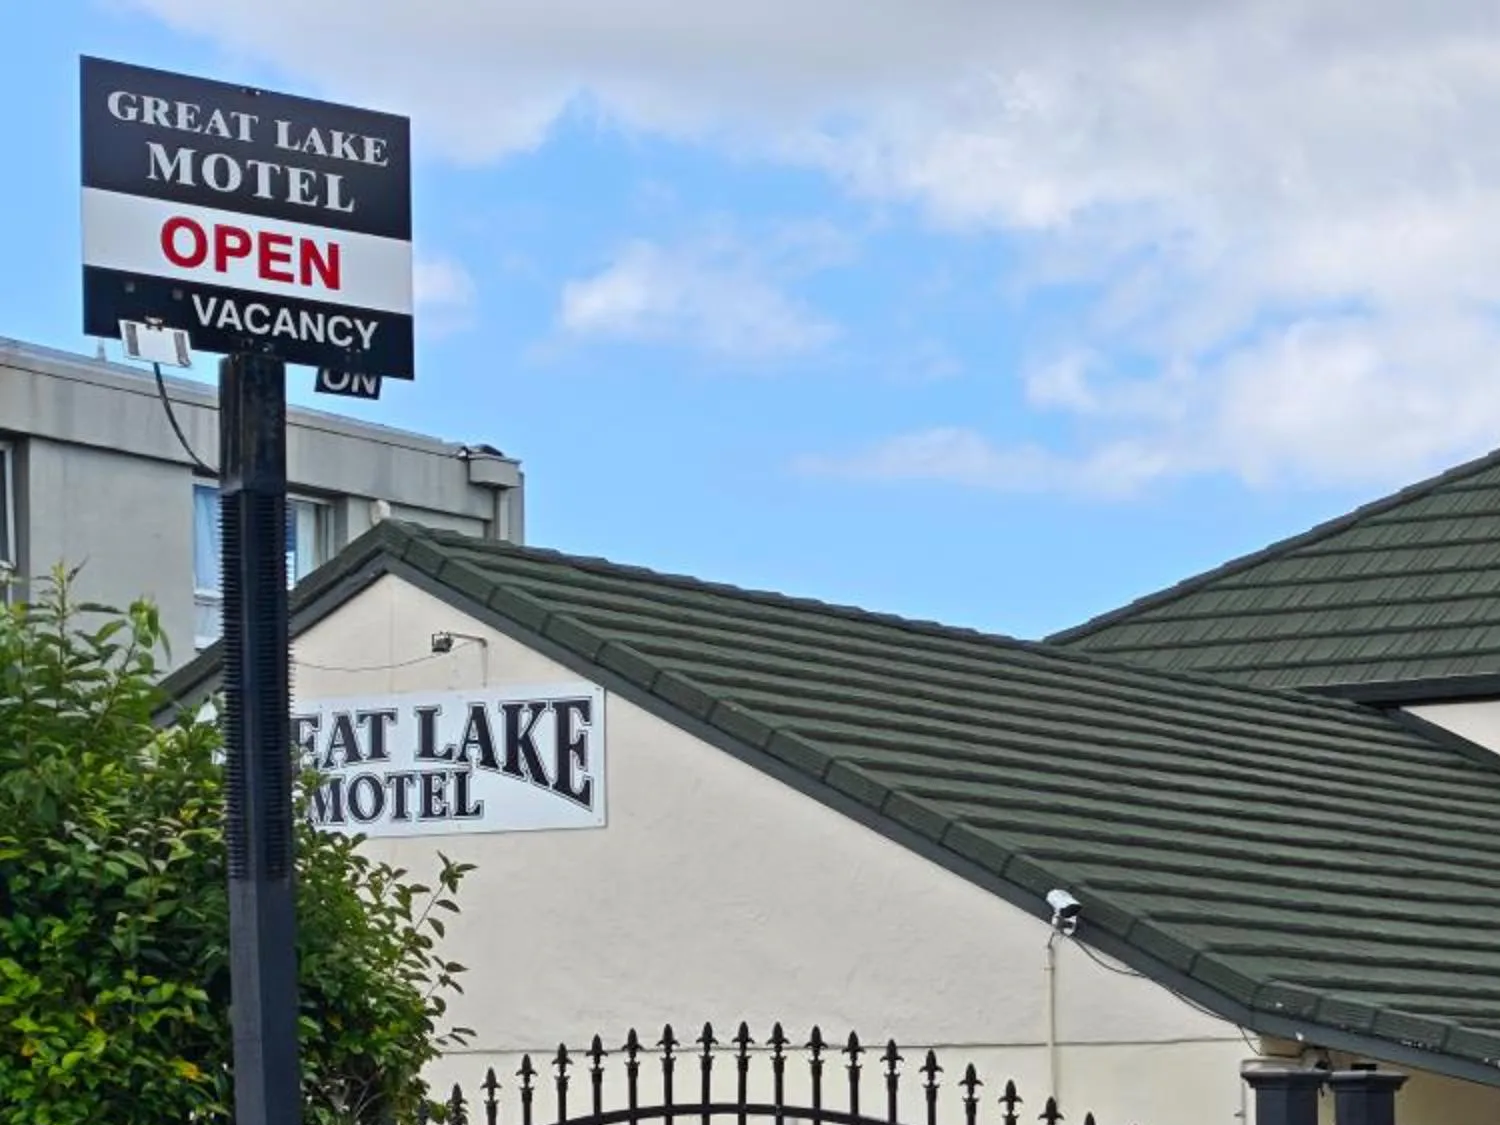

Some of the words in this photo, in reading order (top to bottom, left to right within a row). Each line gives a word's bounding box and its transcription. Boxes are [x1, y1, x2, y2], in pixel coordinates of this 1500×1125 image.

[107, 90, 258, 143] GREAT
[275, 119, 389, 167] LAKE
[146, 142, 355, 213] MOTEL
[160, 216, 341, 290] OPEN
[192, 294, 379, 350] VACANCY
[290, 707, 397, 769] EAT
[414, 697, 593, 811] LAKE
